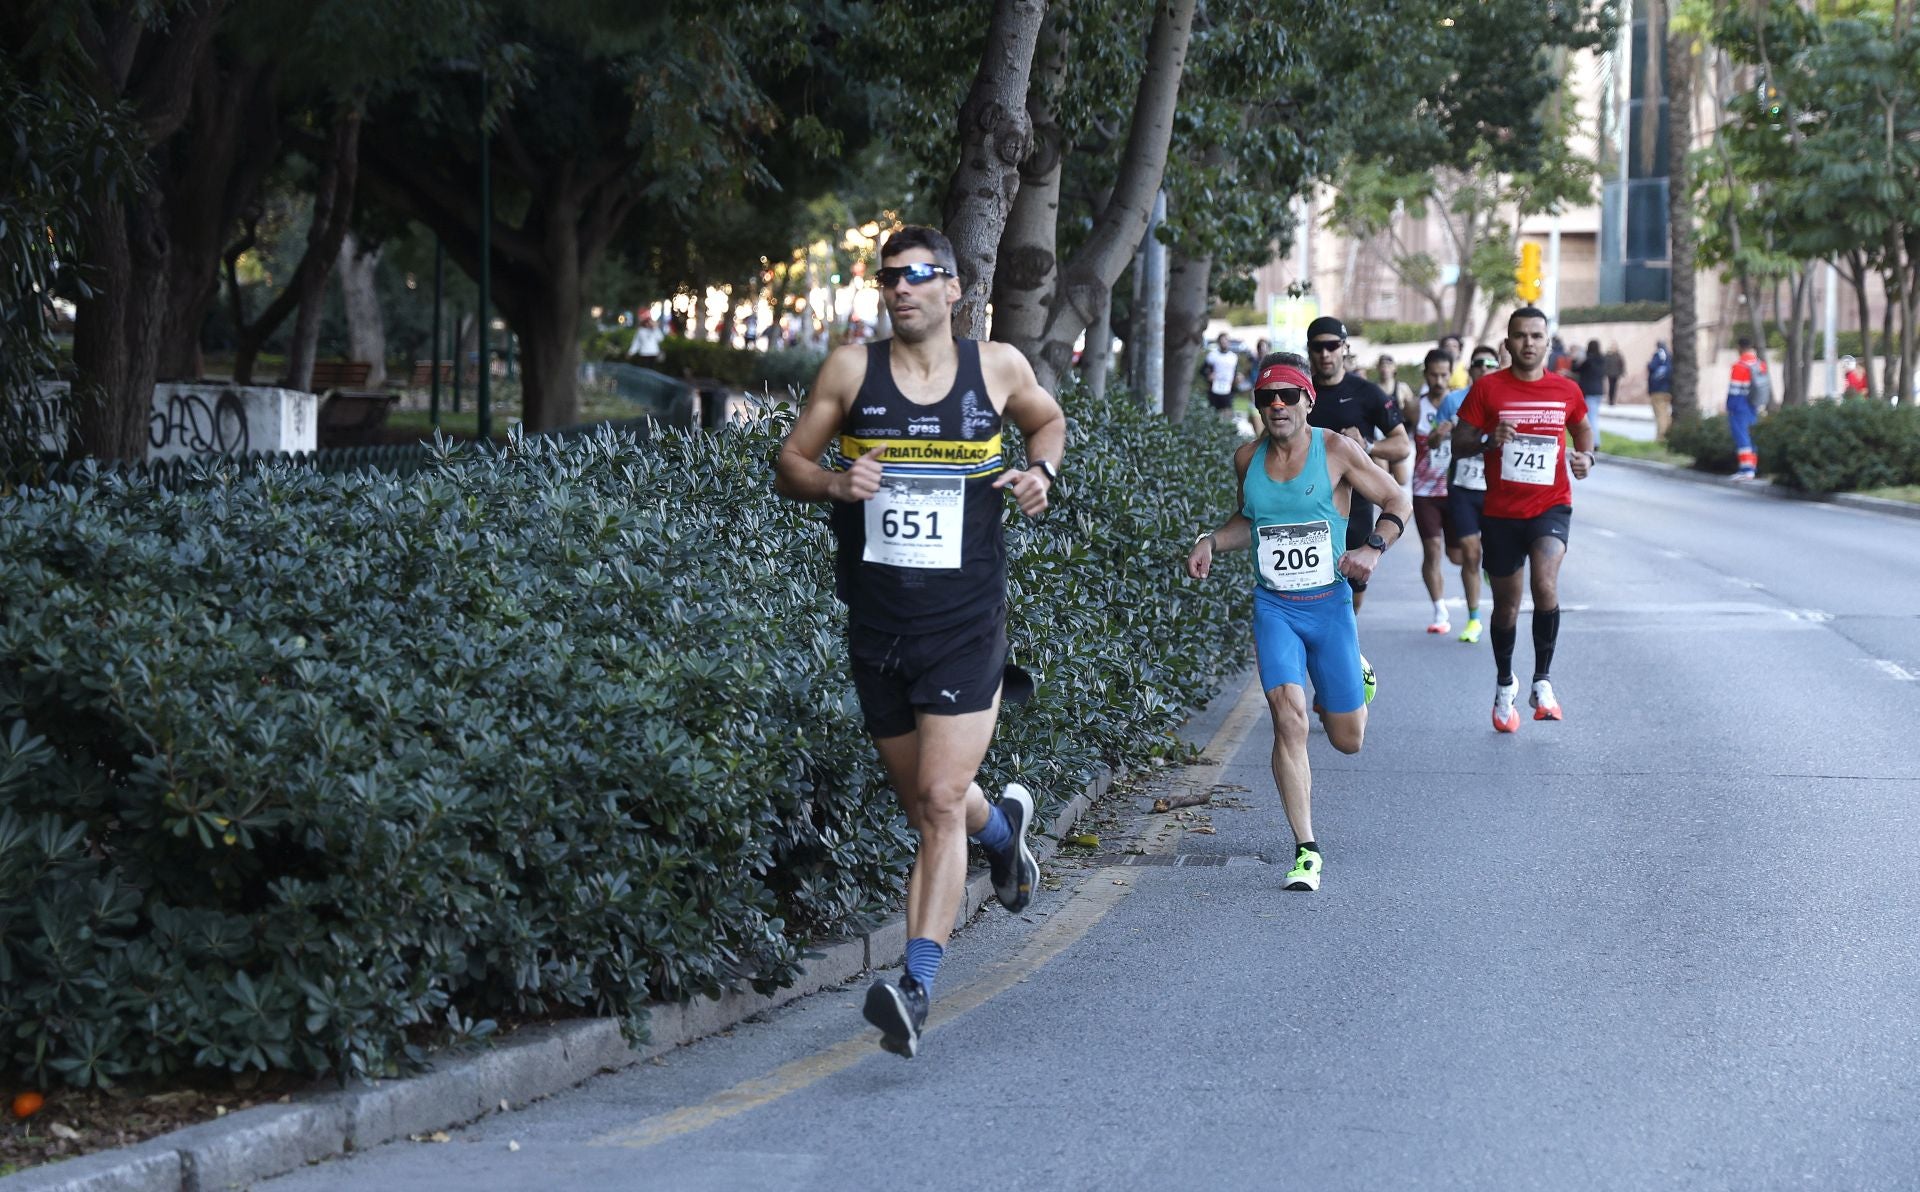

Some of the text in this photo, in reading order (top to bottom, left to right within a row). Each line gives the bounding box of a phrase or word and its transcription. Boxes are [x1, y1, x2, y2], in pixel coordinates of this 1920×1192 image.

[862, 405, 887, 415] vive
[884, 443, 942, 459] TRIATLÓN
[1514, 451, 1546, 470] 741
[882, 509, 942, 540] 651
[1272, 546, 1320, 571] 206
